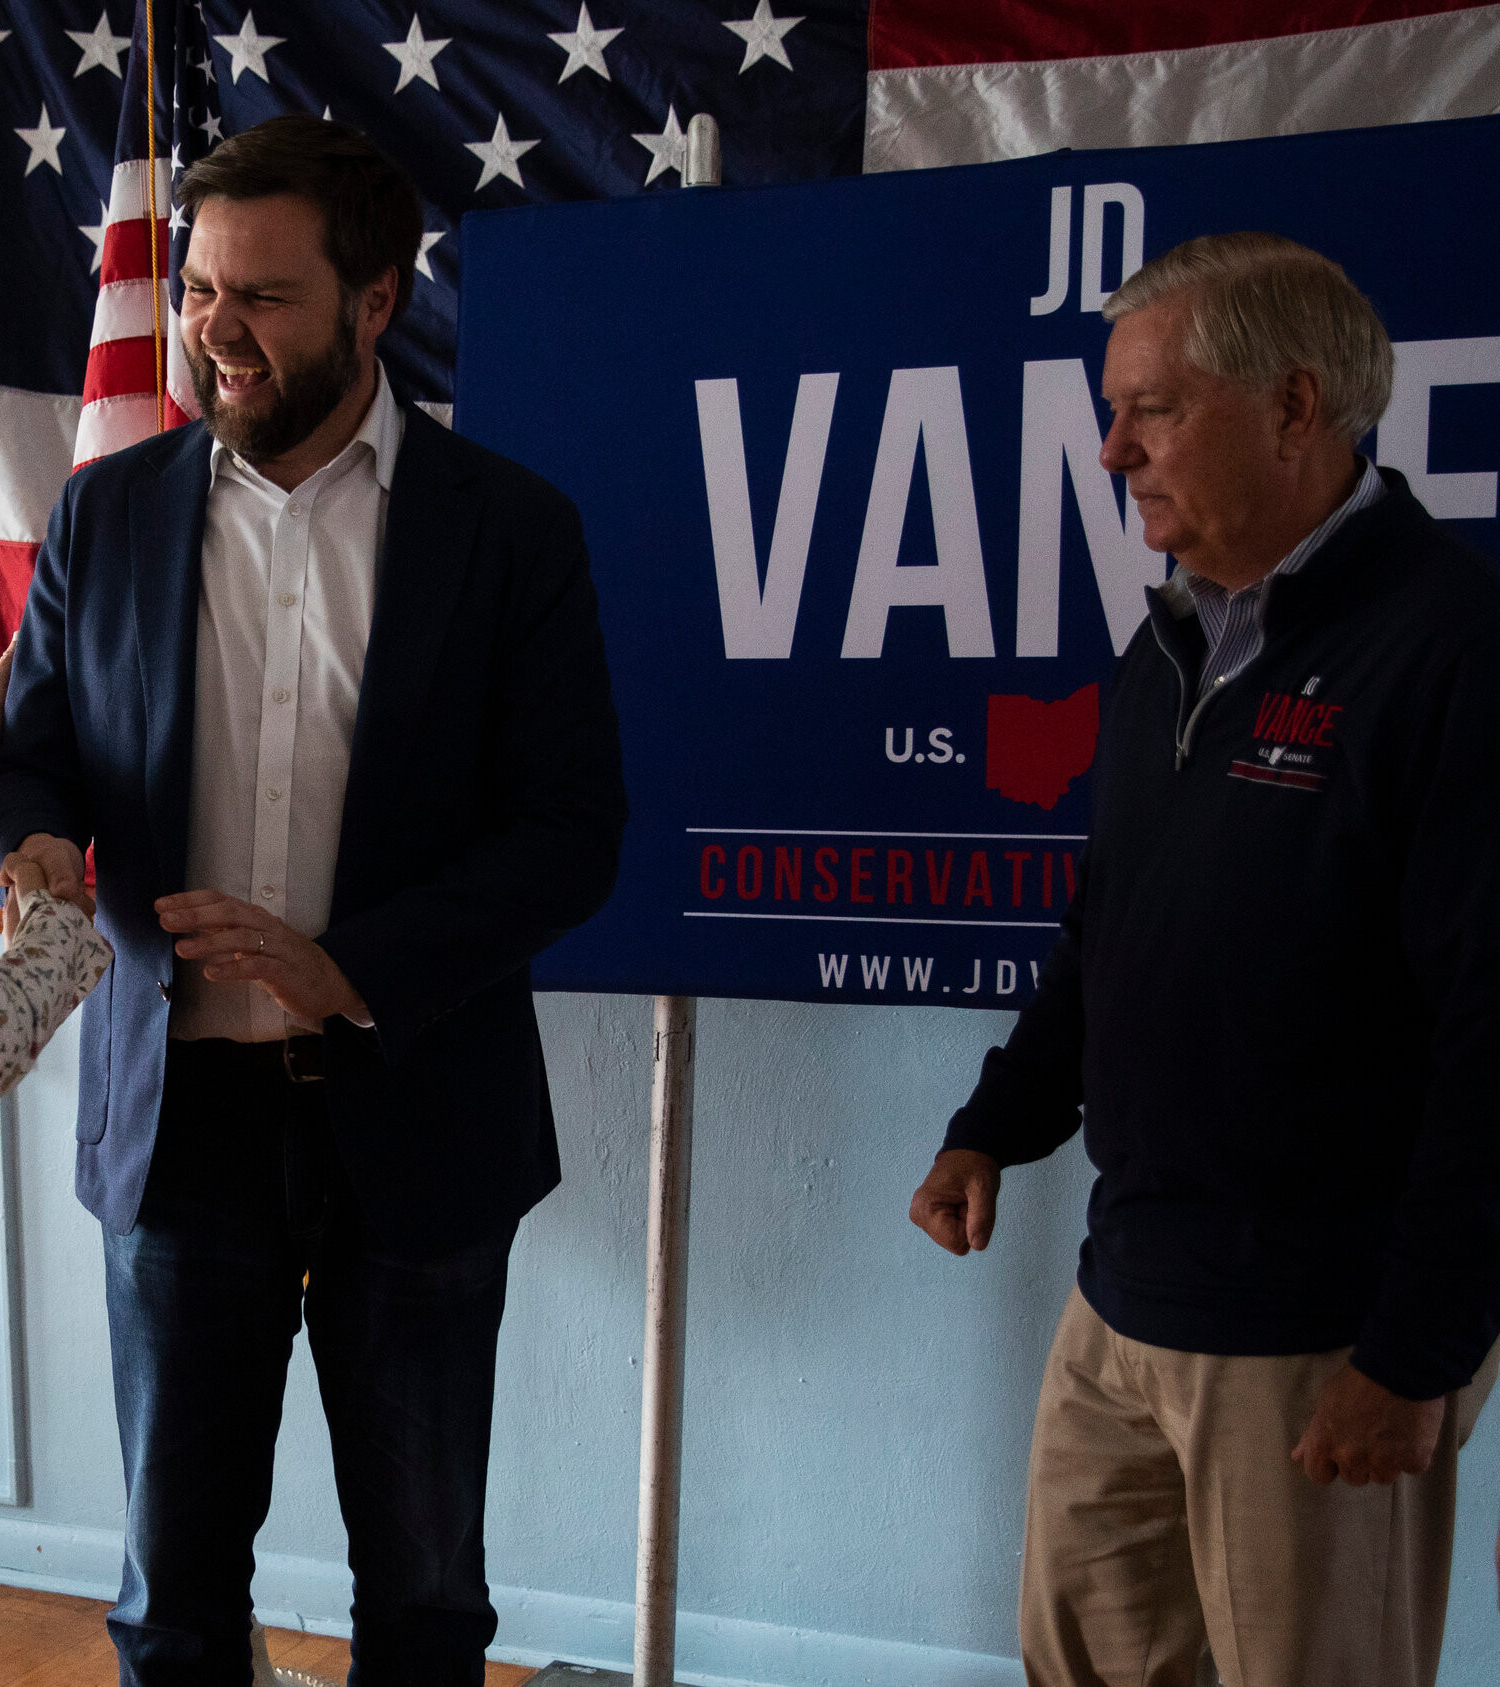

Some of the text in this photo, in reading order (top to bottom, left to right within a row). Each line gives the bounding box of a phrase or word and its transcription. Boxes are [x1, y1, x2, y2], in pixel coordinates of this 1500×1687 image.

[1030, 182, 1145, 317] JD
[694, 335, 1500, 660] VANE
[884, 727, 967, 764] U.S.
[1253, 691, 1344, 747] VANCE
[1283, 752, 1312, 764] SENATE
